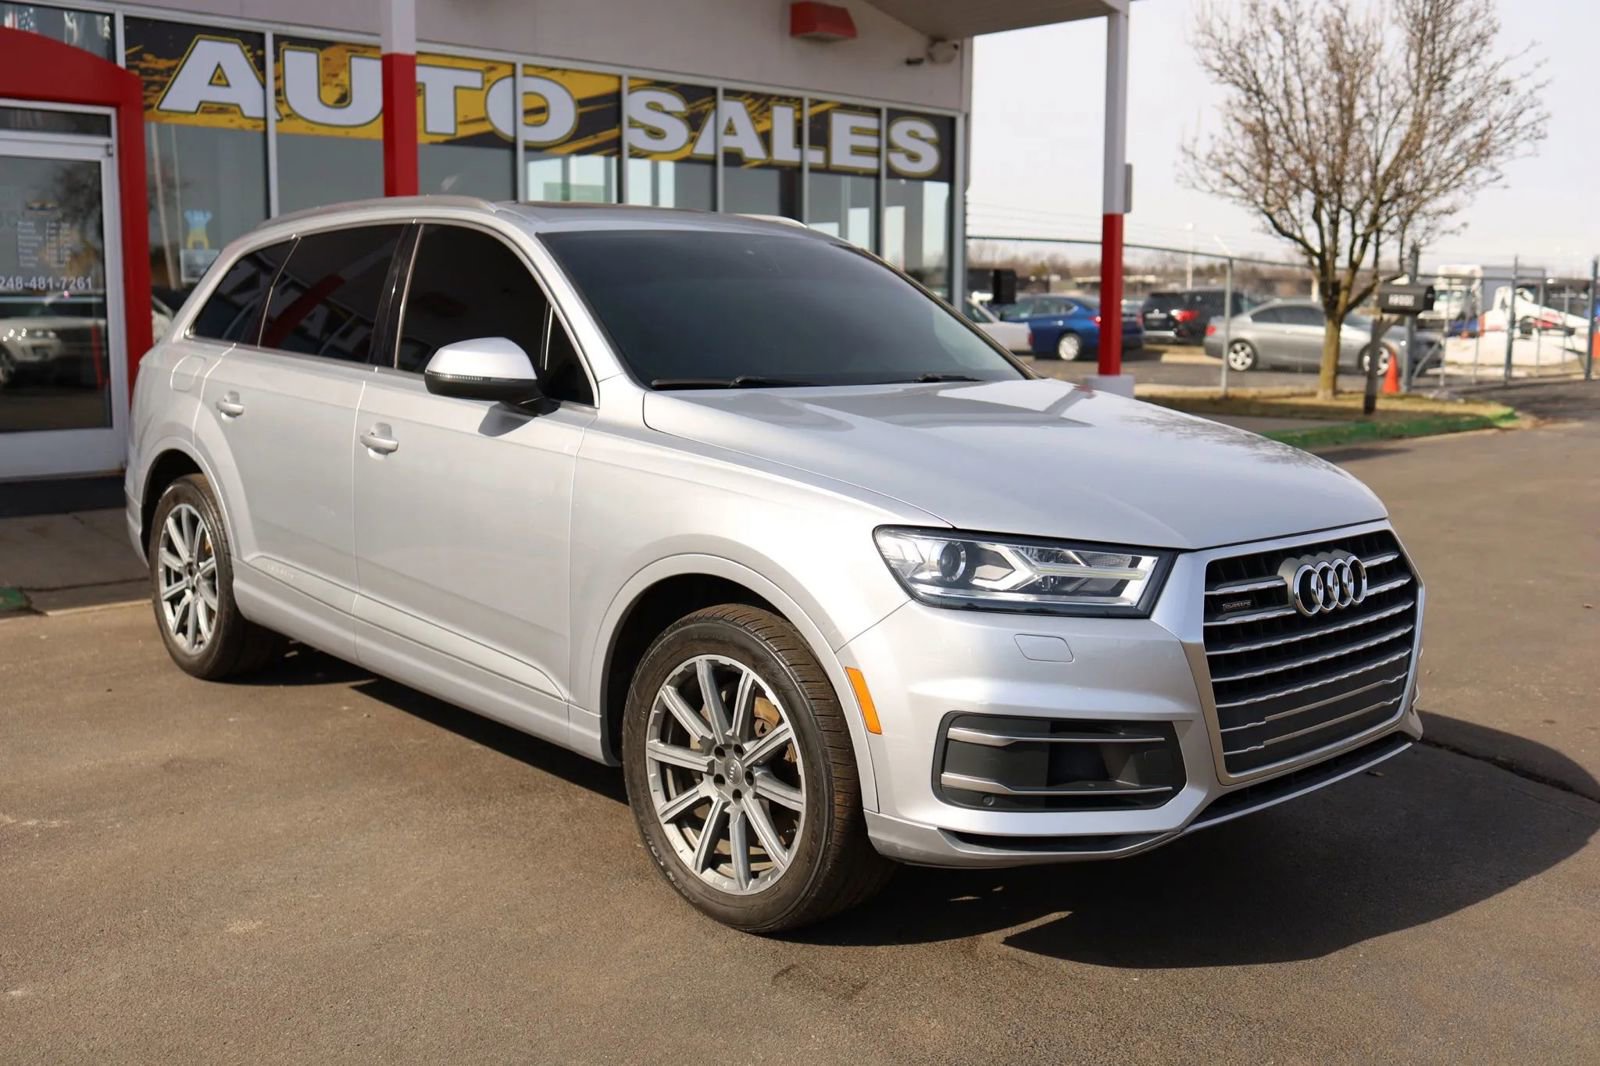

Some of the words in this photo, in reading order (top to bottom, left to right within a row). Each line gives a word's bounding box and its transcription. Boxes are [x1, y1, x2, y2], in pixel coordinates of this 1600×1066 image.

[156, 35, 577, 146] AUTO
[627, 87, 941, 177] SALES
[0, 276, 93, 290] 248-481-7261
